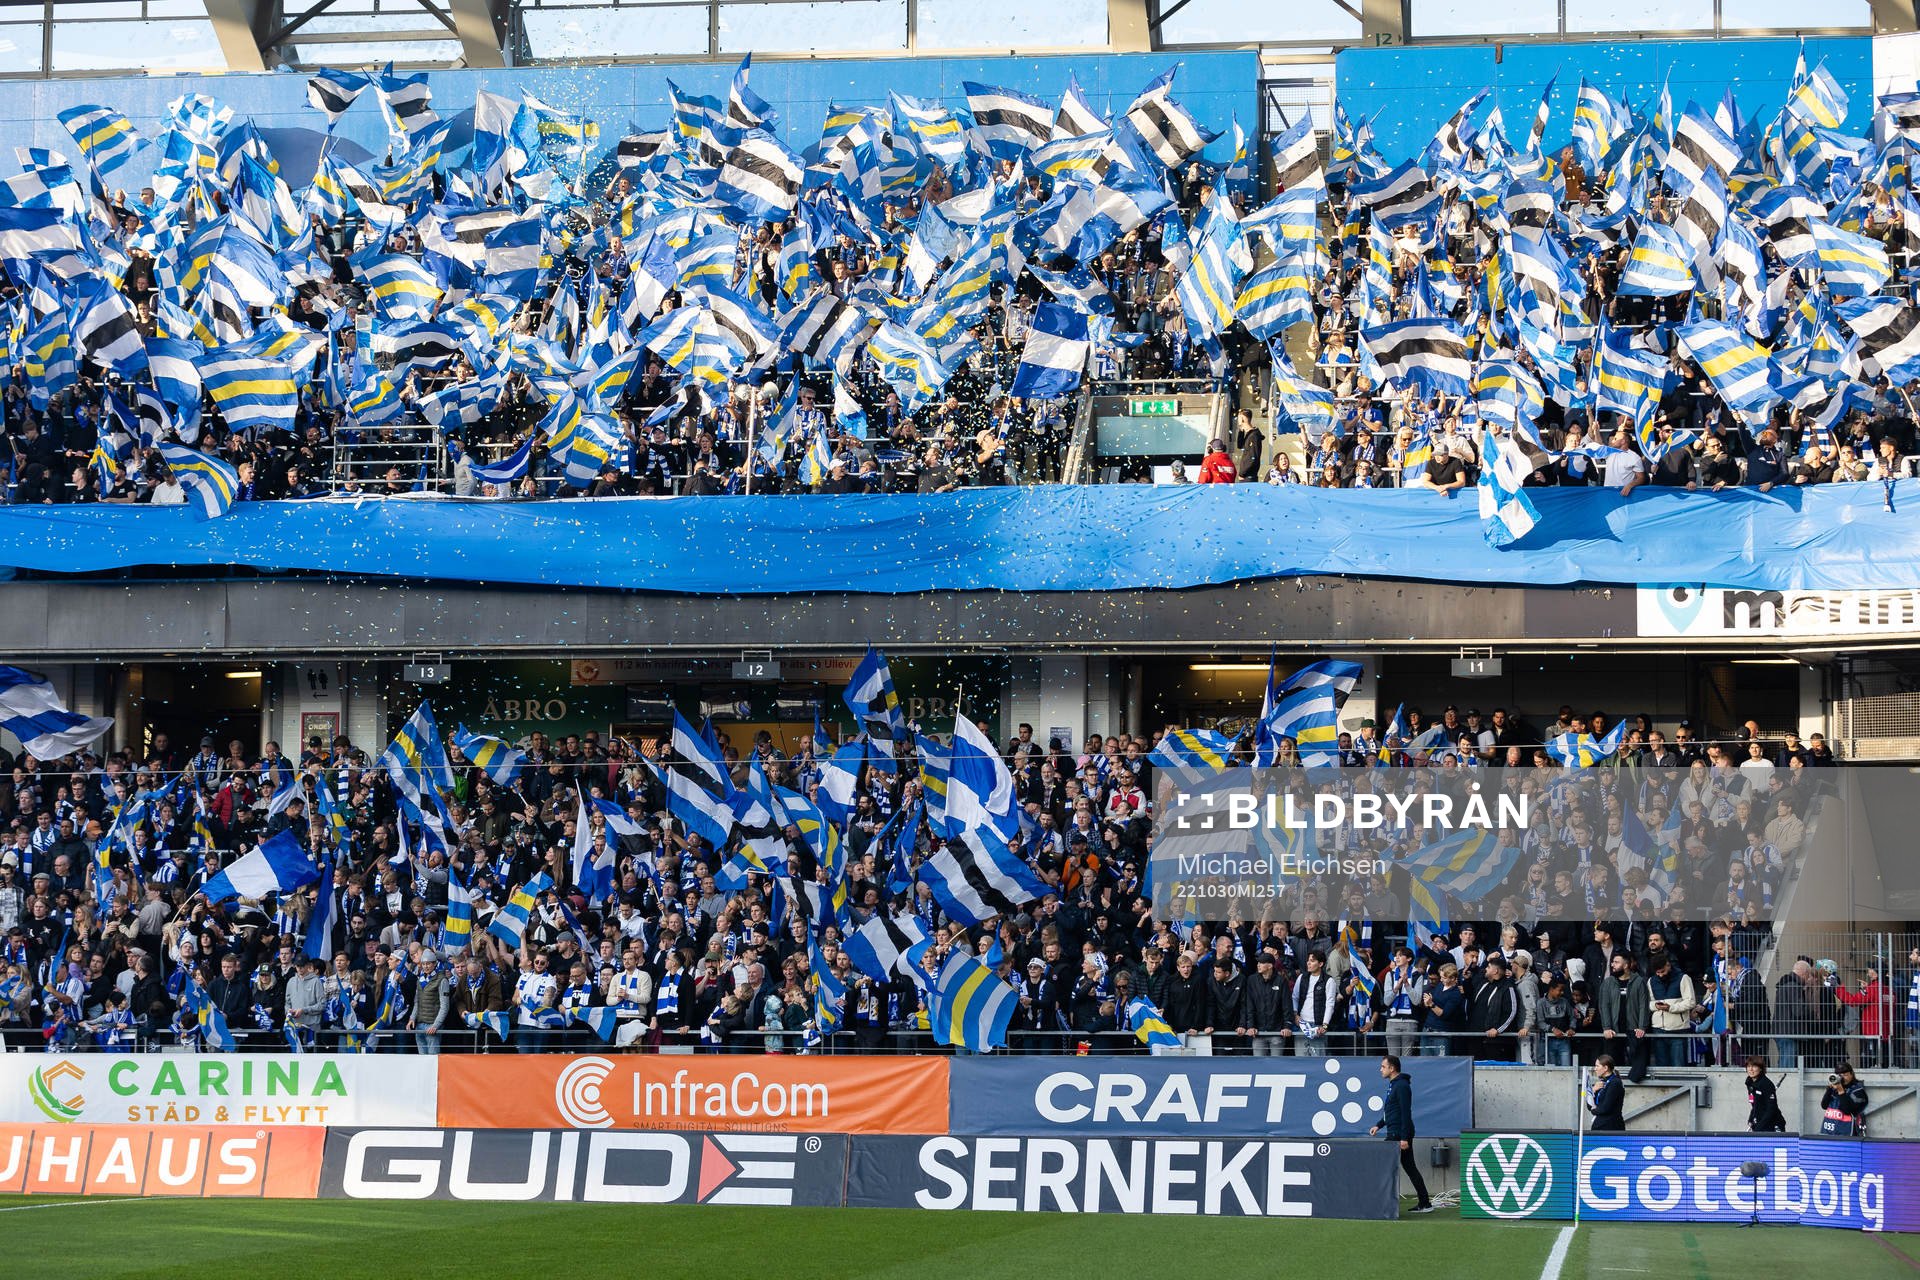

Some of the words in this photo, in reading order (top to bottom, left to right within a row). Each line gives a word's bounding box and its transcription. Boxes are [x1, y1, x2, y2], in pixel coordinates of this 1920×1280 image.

[420, 667, 435, 678] 13
[749, 664, 764, 676] 12
[1470, 661, 1484, 673] 11
[482, 696, 567, 721] ÅBRO
[903, 697, 972, 719] BRO
[108, 1060, 349, 1097] CARINA
[632, 1069, 829, 1118] InfraCom
[1034, 1071, 1306, 1123] CRAFT
[127, 1102, 201, 1122] STÄD
[214, 1105, 230, 1122] &
[244, 1106, 329, 1122] FLYTT
[1579, 1145, 1885, 1231] Göteborg
